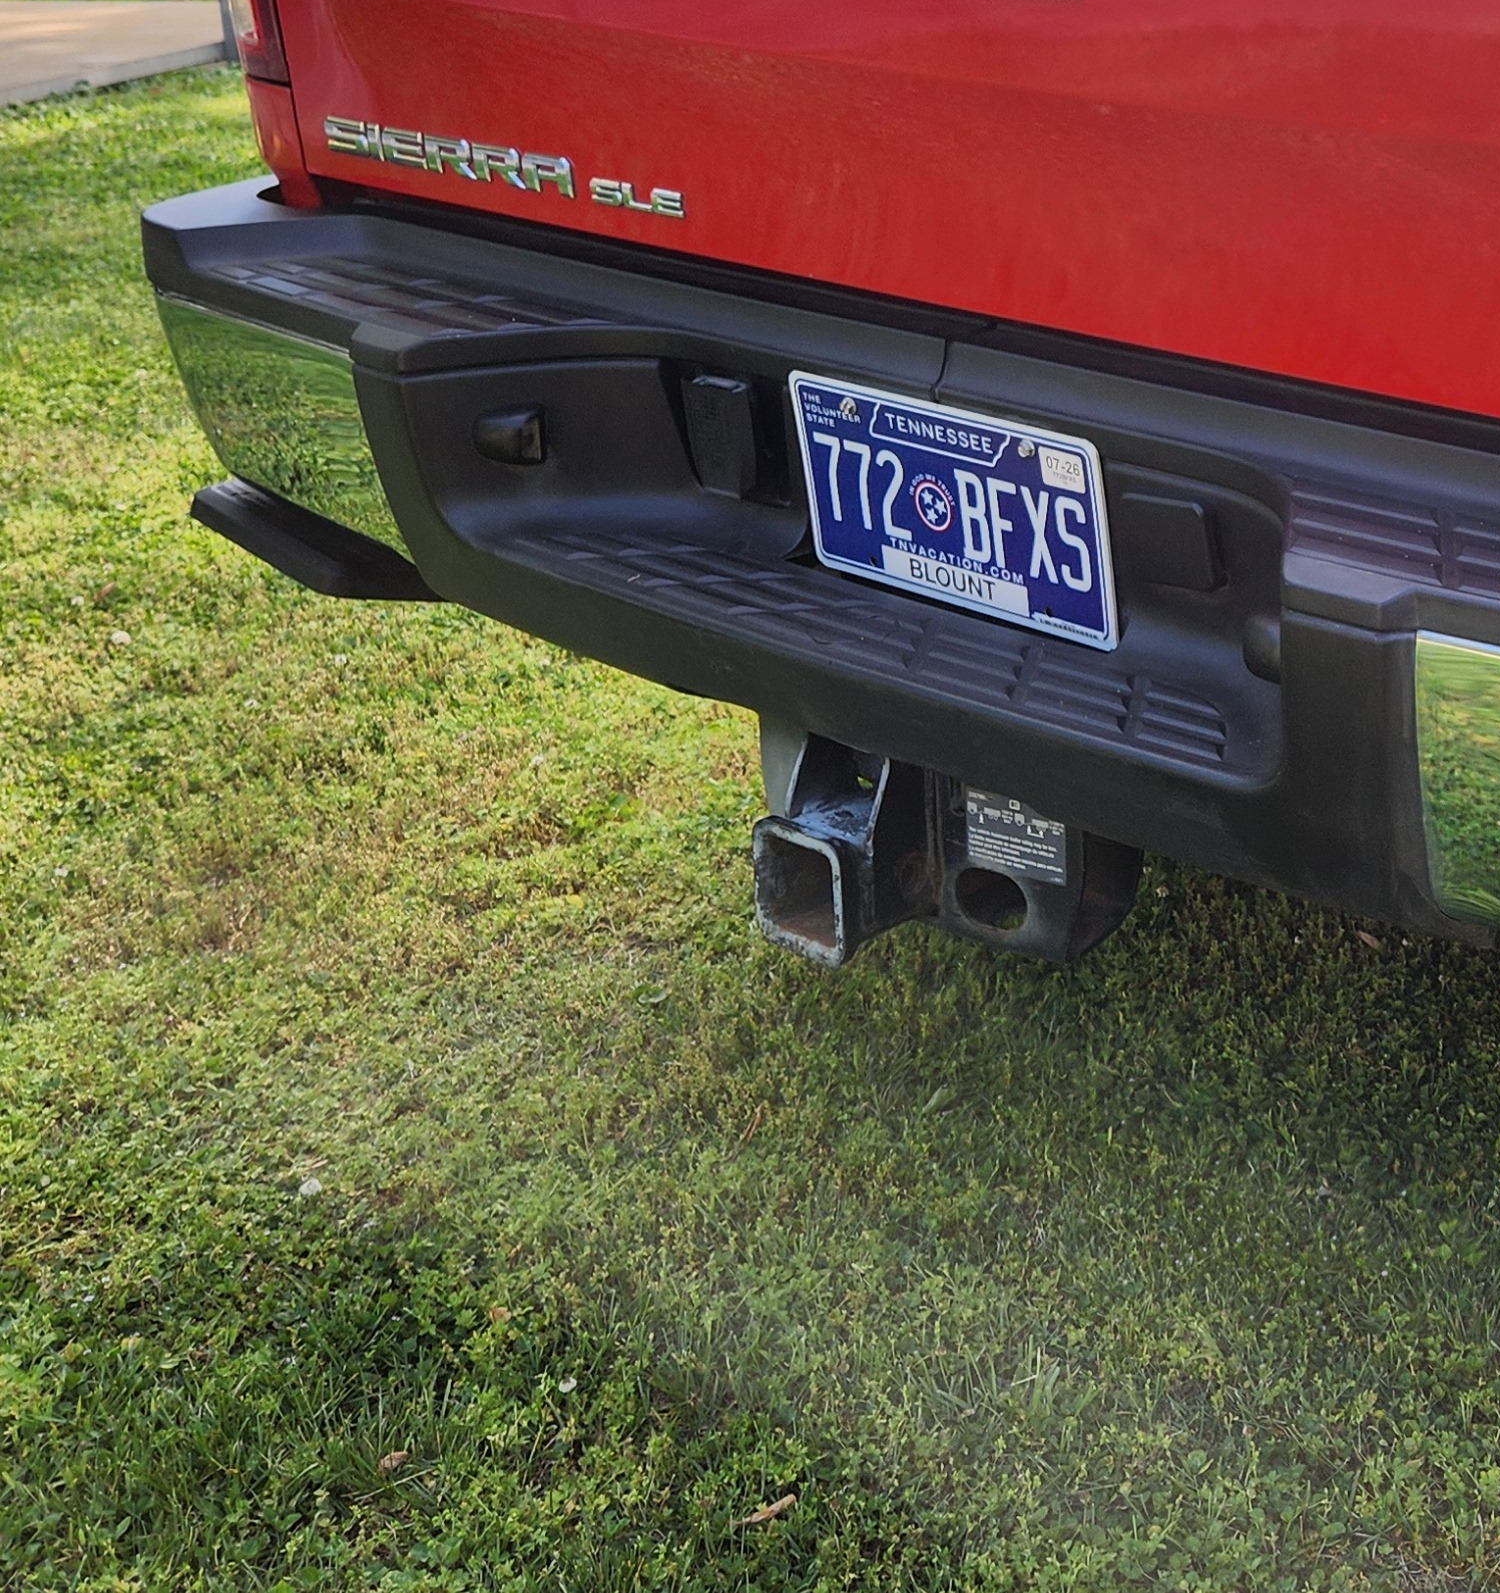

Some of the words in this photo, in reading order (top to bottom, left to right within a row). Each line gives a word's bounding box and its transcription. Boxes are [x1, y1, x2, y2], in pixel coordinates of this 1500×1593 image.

[323, 115, 576, 199] SIERRA
[589, 176, 685, 219] SLE
[802, 391, 821, 404] THE
[804, 402, 862, 424] VOLUNTEER
[806, 413, 836, 428] STATE
[884, 412, 994, 455] TENNESSEE
[1046, 455, 1080, 477] 07-26
[813, 431, 912, 541] 772
[953, 468, 1093, 593] BFXS
[889, 537, 1024, 585] TNVACATION.COM
[909, 558, 996, 601] BLOUNT
